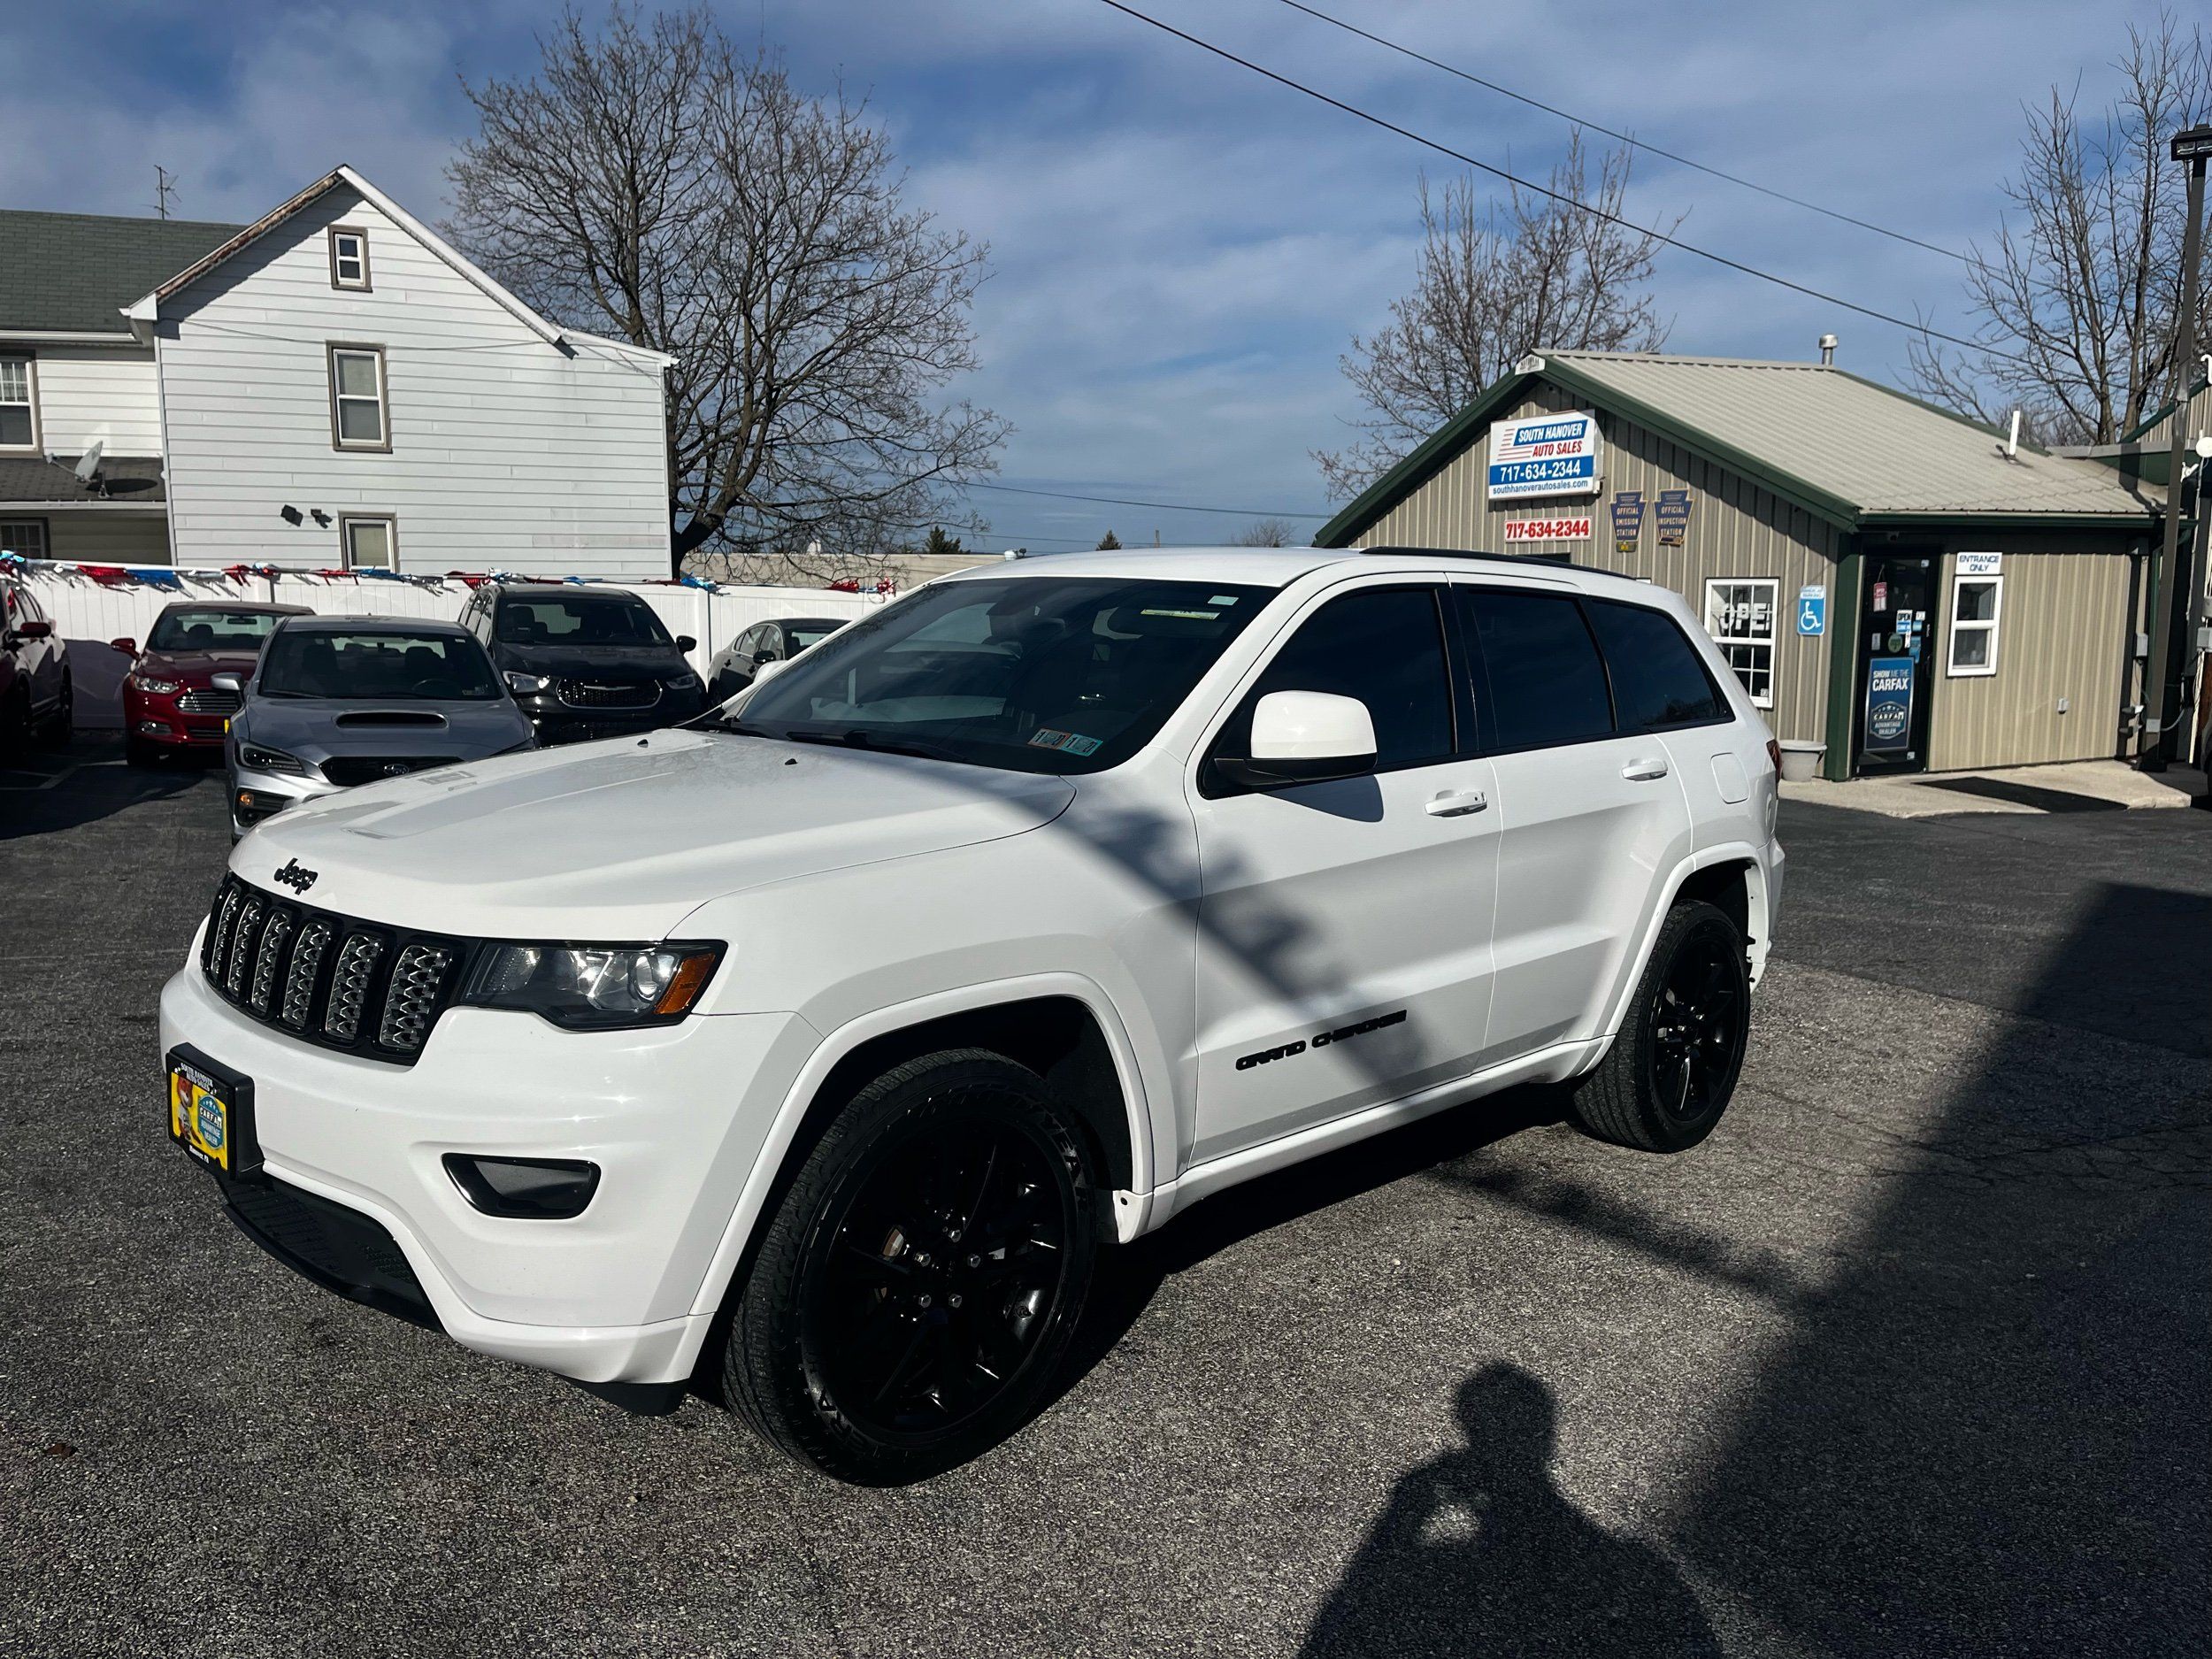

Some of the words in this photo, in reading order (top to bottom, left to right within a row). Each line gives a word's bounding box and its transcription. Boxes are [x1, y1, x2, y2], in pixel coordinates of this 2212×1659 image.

[1518, 428, 1544, 442] SOUTH
[1545, 423, 1583, 437] HANOVER
[1532, 443, 1555, 457] AUTO
[1556, 441, 1582, 455] SALES
[1500, 459, 1581, 482] 717-634-2344
[1493, 480, 1588, 495] southhanoverautosales.com
[1617, 507, 1639, 516] OFFICIAL
[1506, 519, 1589, 539] 717-634-2344
[1959, 555, 2000, 564] ENTRANCE
[1873, 670, 1890, 679] SHOW
[1872, 678, 1910, 692] CARFAX
[273, 857, 319, 895] Jeep
[1235, 1040, 1307, 1071] GRAND
